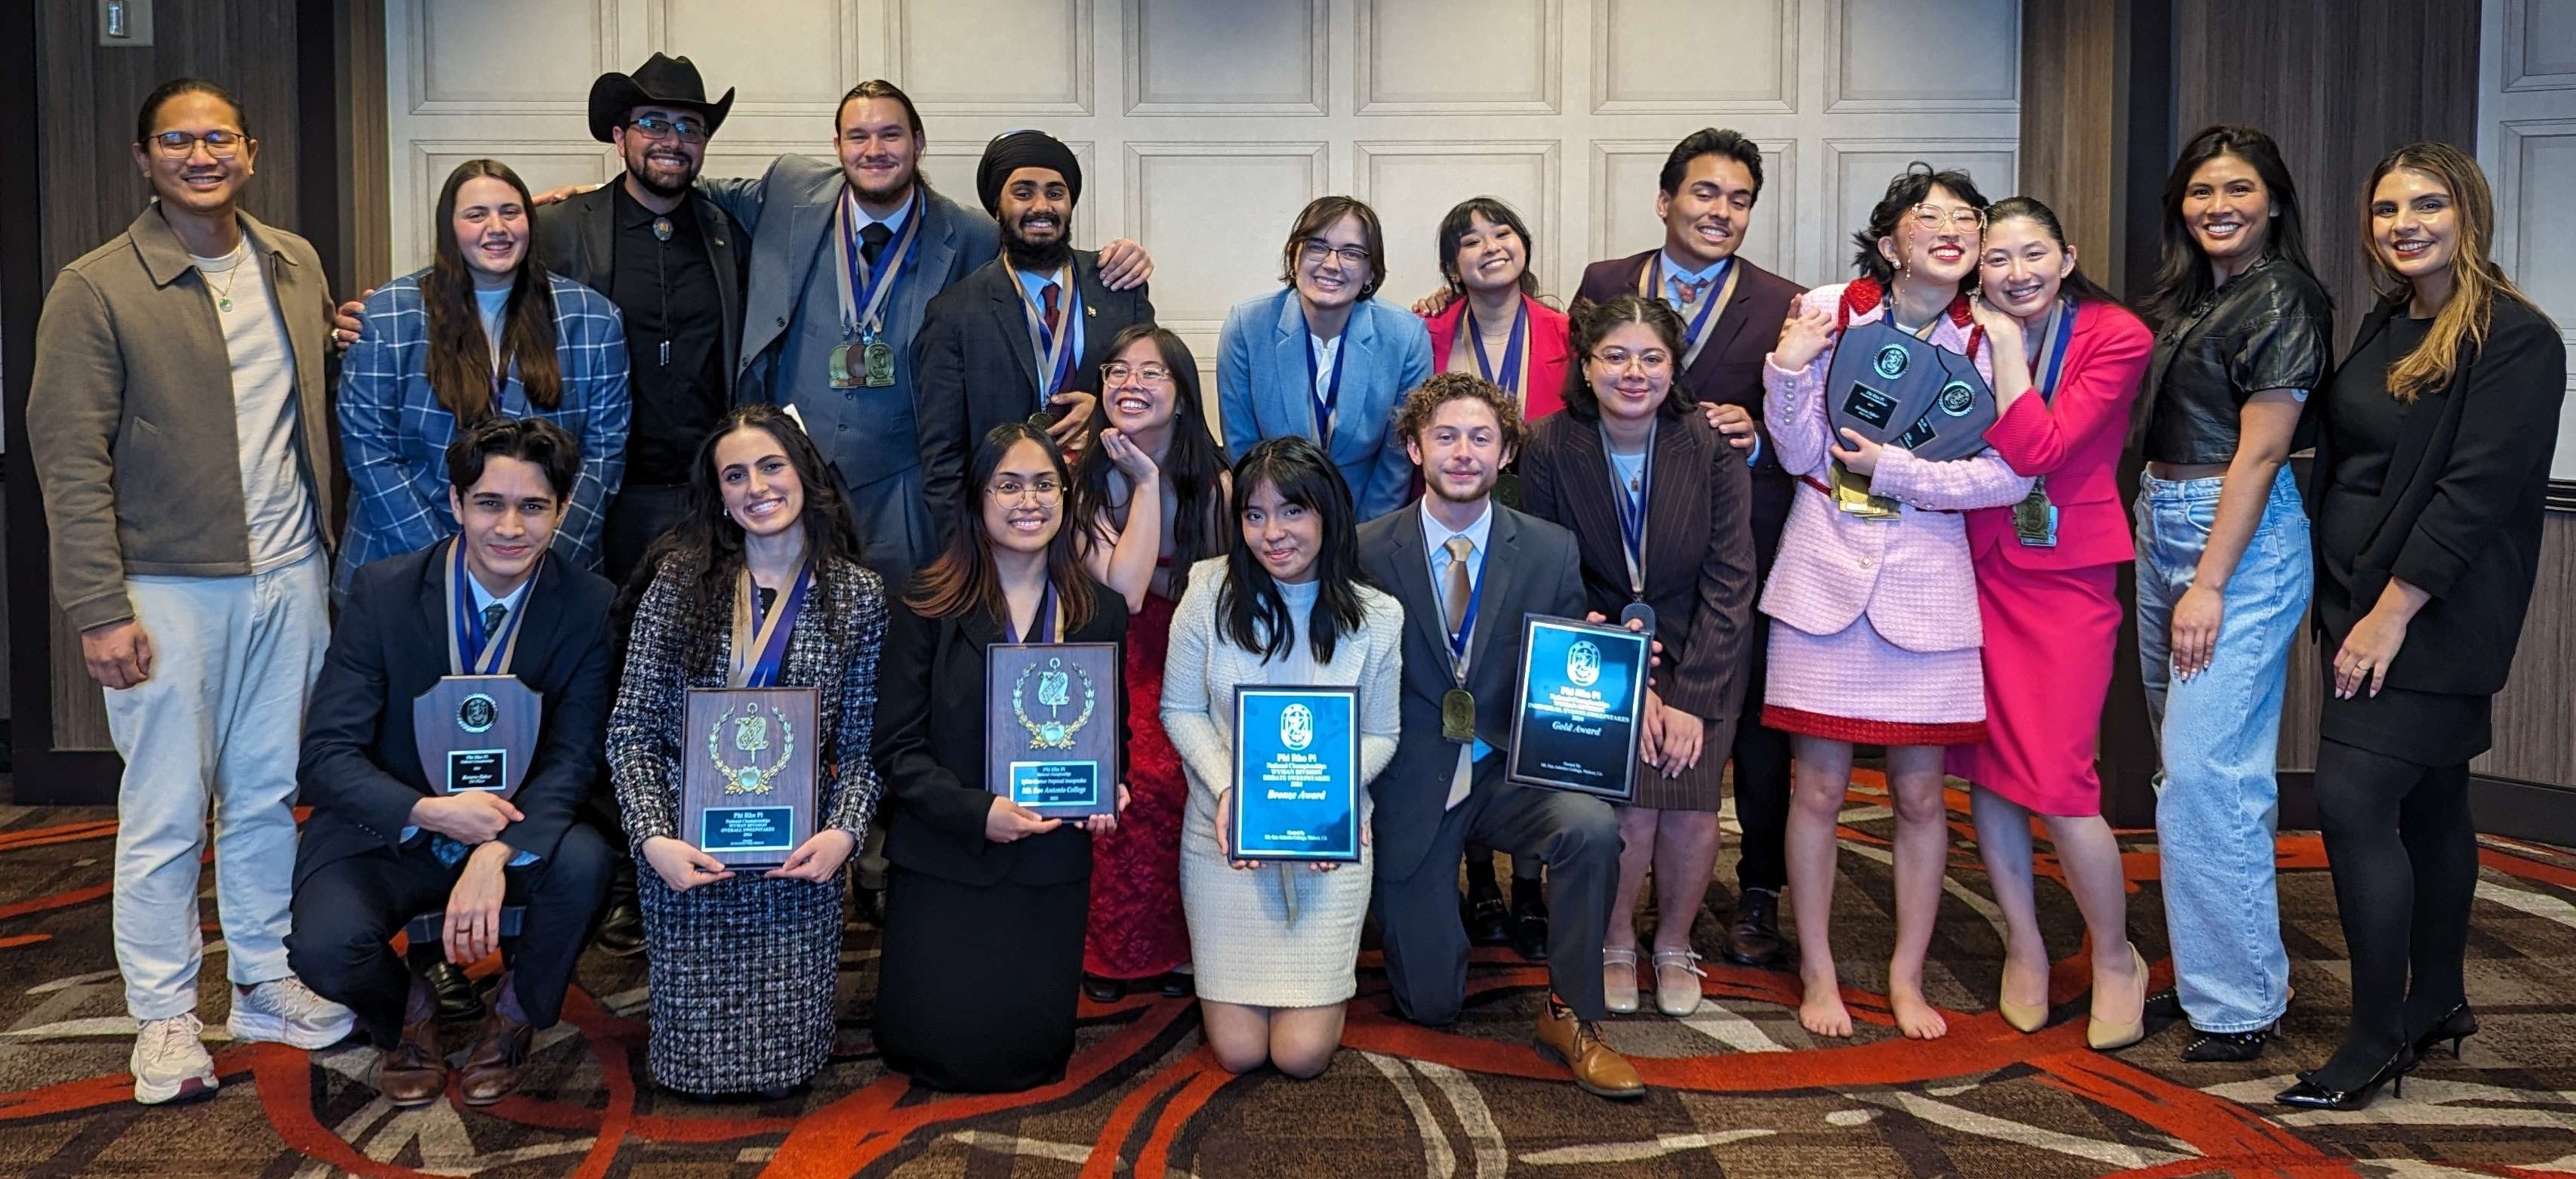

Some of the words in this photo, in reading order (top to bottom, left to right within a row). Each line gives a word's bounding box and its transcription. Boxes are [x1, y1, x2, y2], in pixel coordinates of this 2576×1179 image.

[1552, 721, 1573, 733] Gold
[1573, 724, 1602, 736] Award
[1277, 753, 1290, 762] Phi
[1291, 753, 1308, 762] Rho
[1308, 753, 1317, 762] Pi
[1267, 789, 1297, 800] Bronze
[1298, 790, 1327, 800] Award
